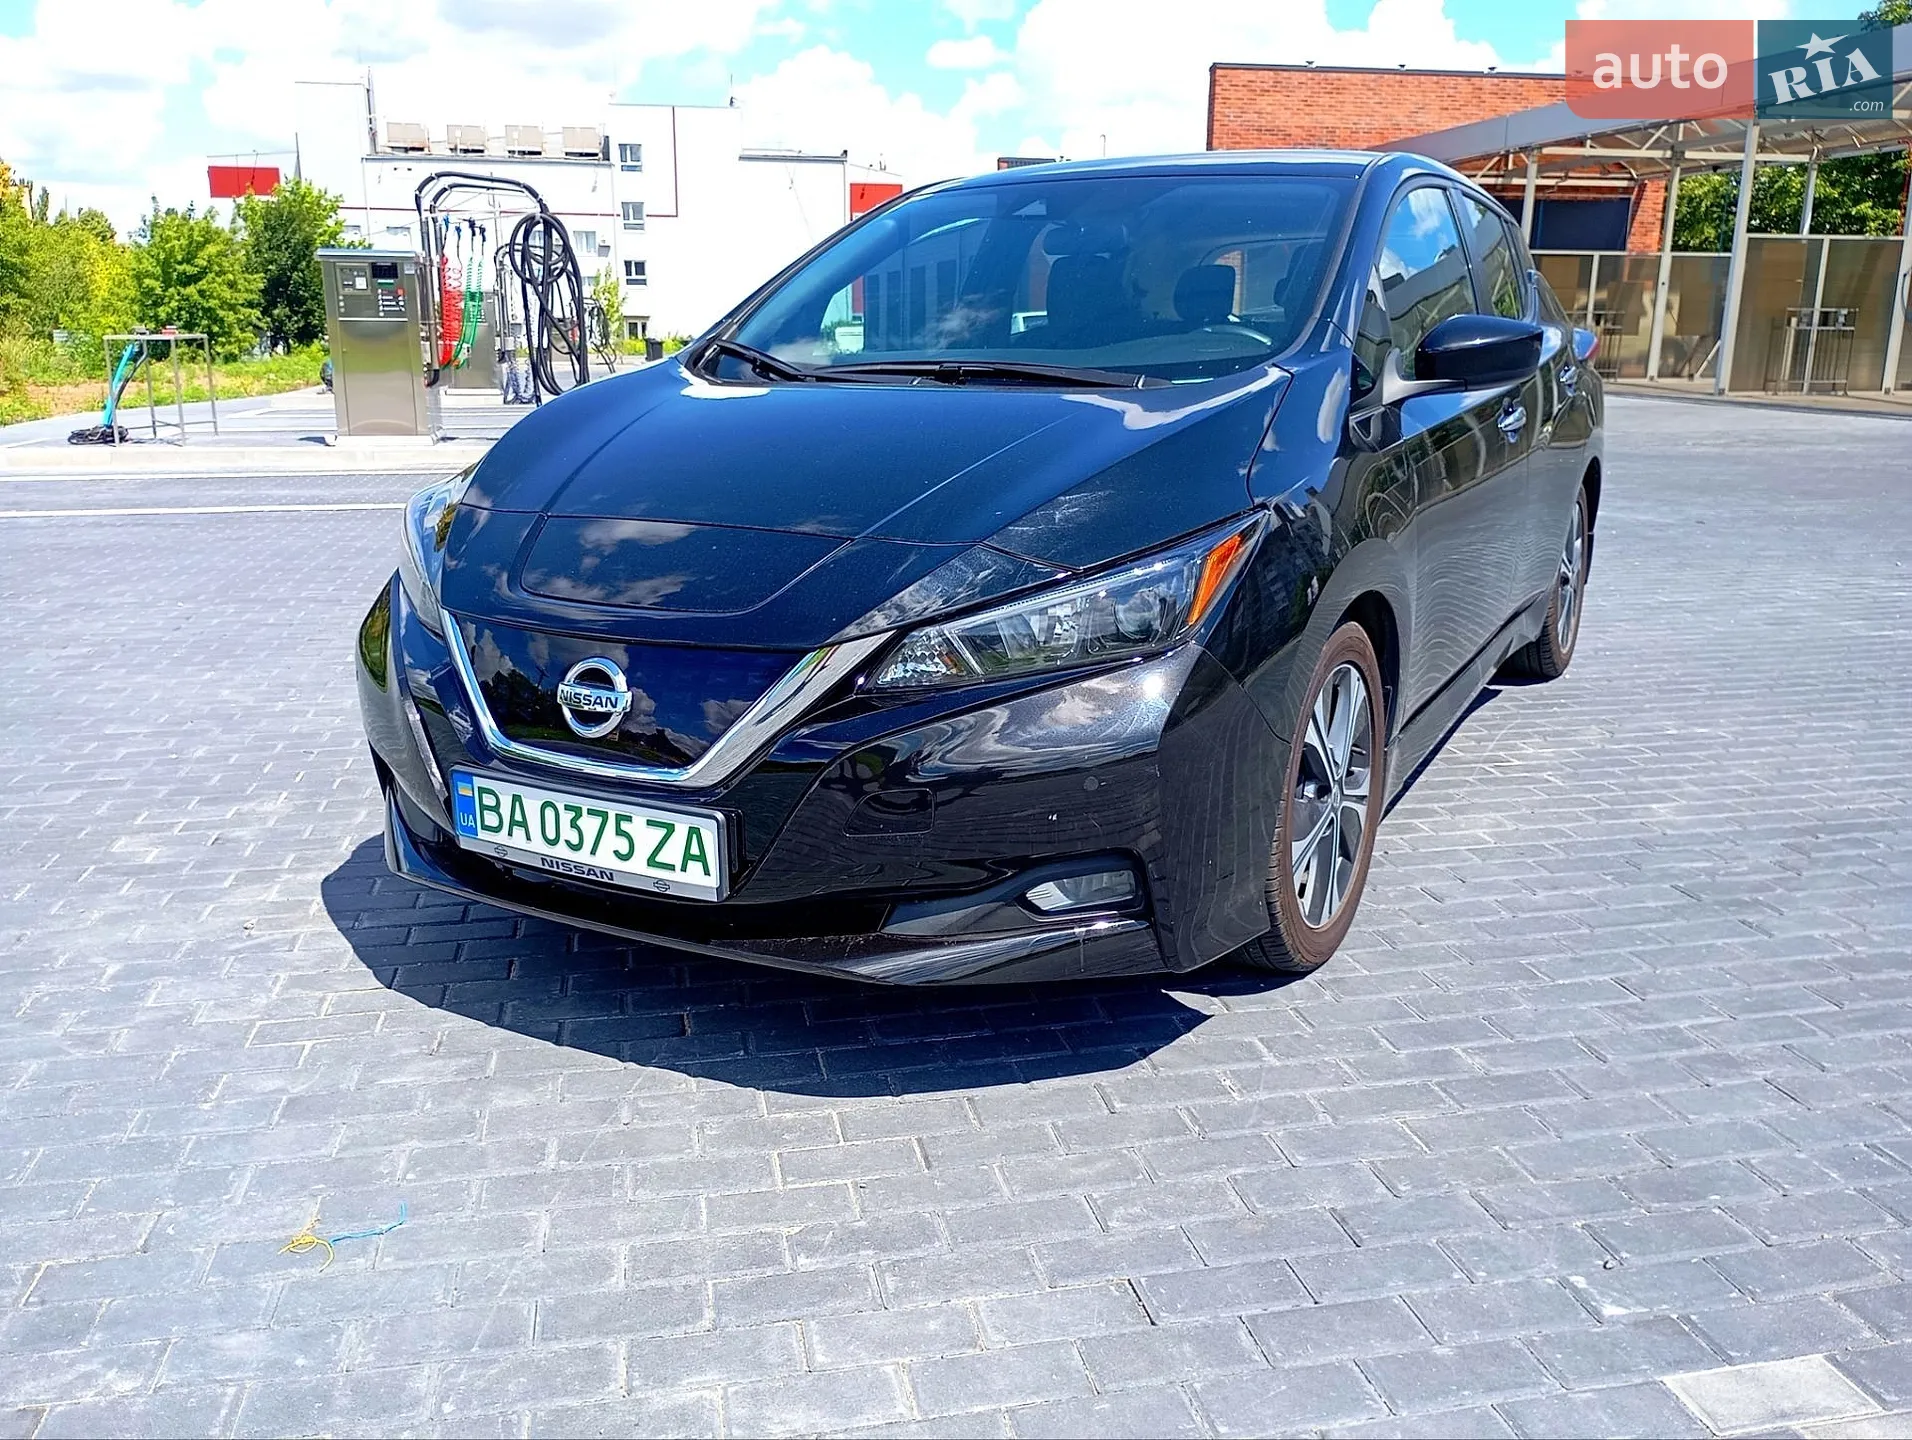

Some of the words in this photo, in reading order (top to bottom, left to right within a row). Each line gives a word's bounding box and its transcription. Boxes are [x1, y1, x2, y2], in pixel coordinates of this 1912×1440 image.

[560, 689, 618, 709] NISSAN
[460, 812, 475, 828] UA
[477, 786, 531, 841] BA
[540, 800, 635, 861] 0375
[646, 820, 711, 876] ZA
[540, 857, 614, 882] NISSAN
